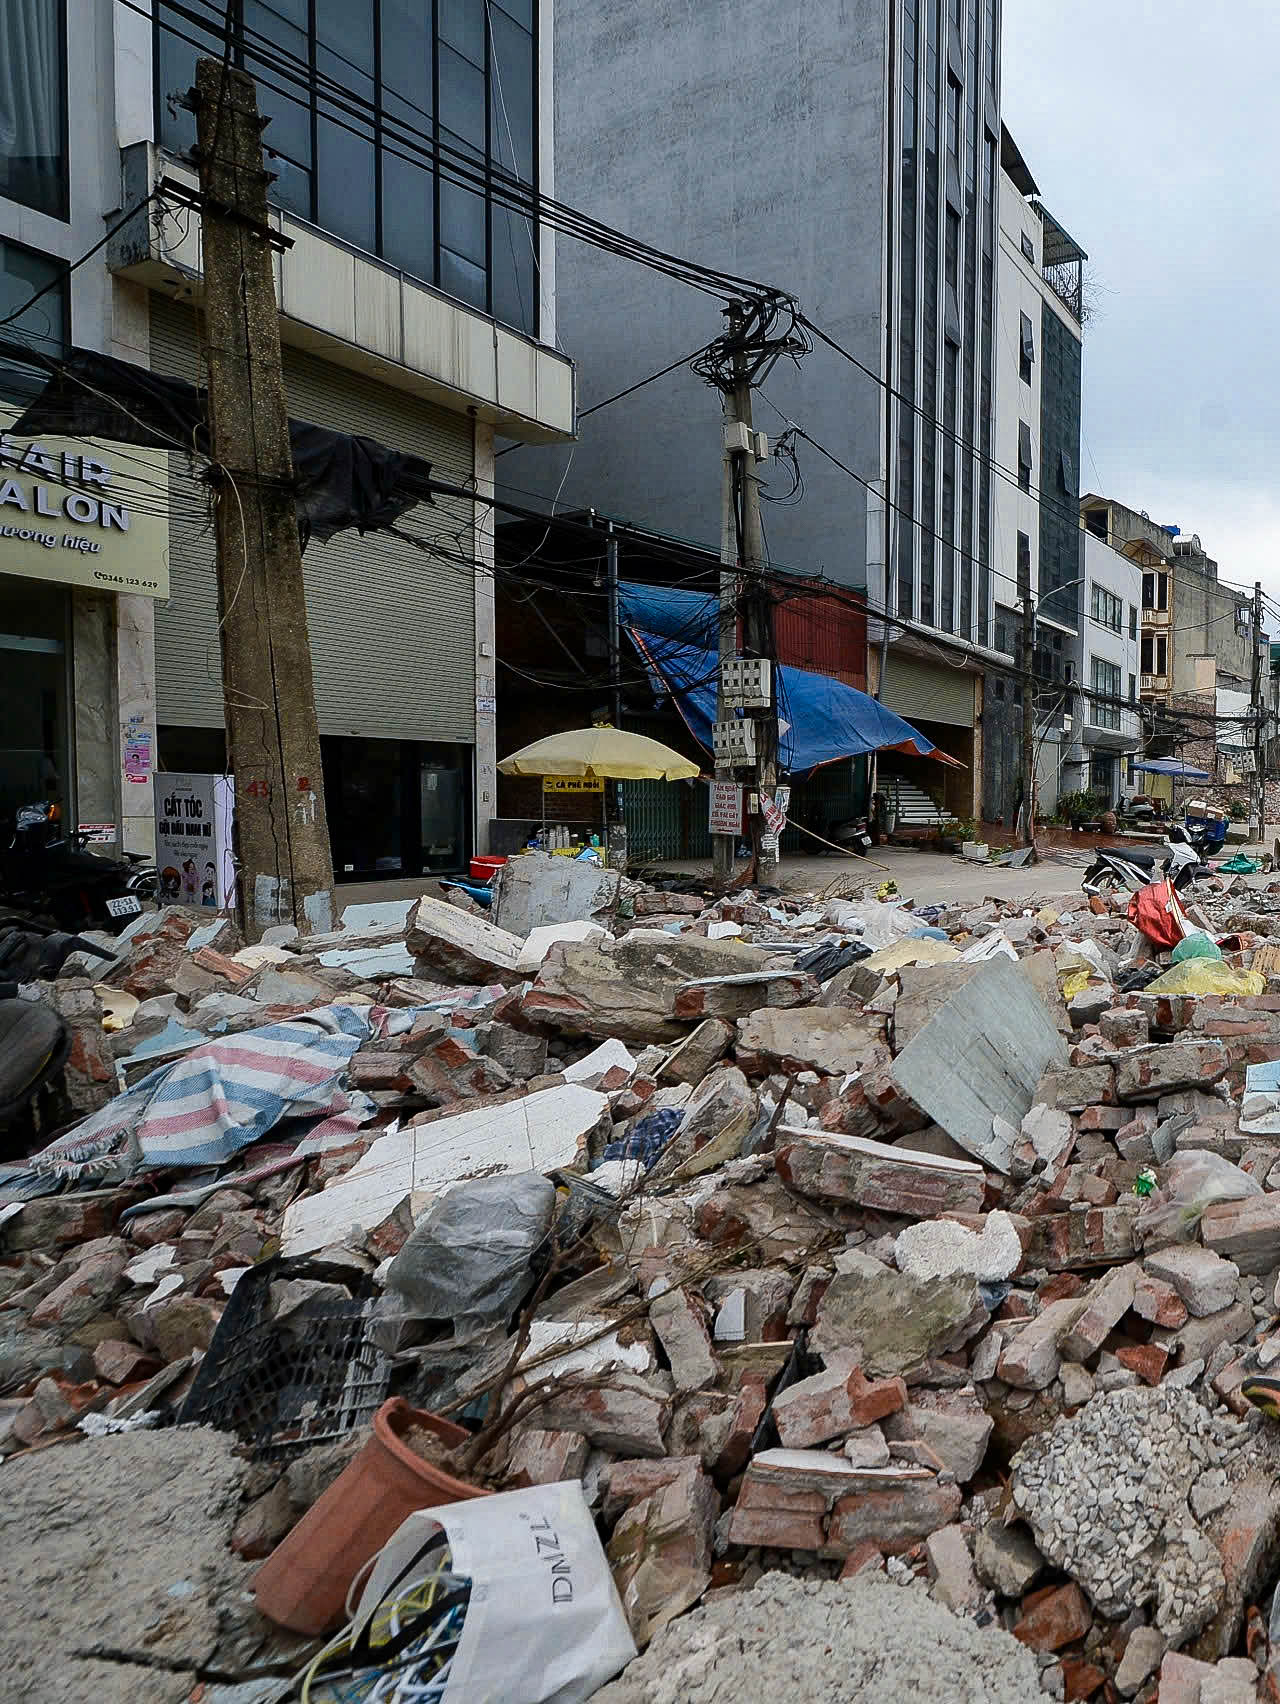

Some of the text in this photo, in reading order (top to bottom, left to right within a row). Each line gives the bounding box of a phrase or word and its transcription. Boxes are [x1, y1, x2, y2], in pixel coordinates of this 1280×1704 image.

[0, 527, 102, 554] ương hiệu
[102, 573, 124, 584] 0345
[126, 577, 140, 586] 123
[184, 795, 202, 819] TÓC
